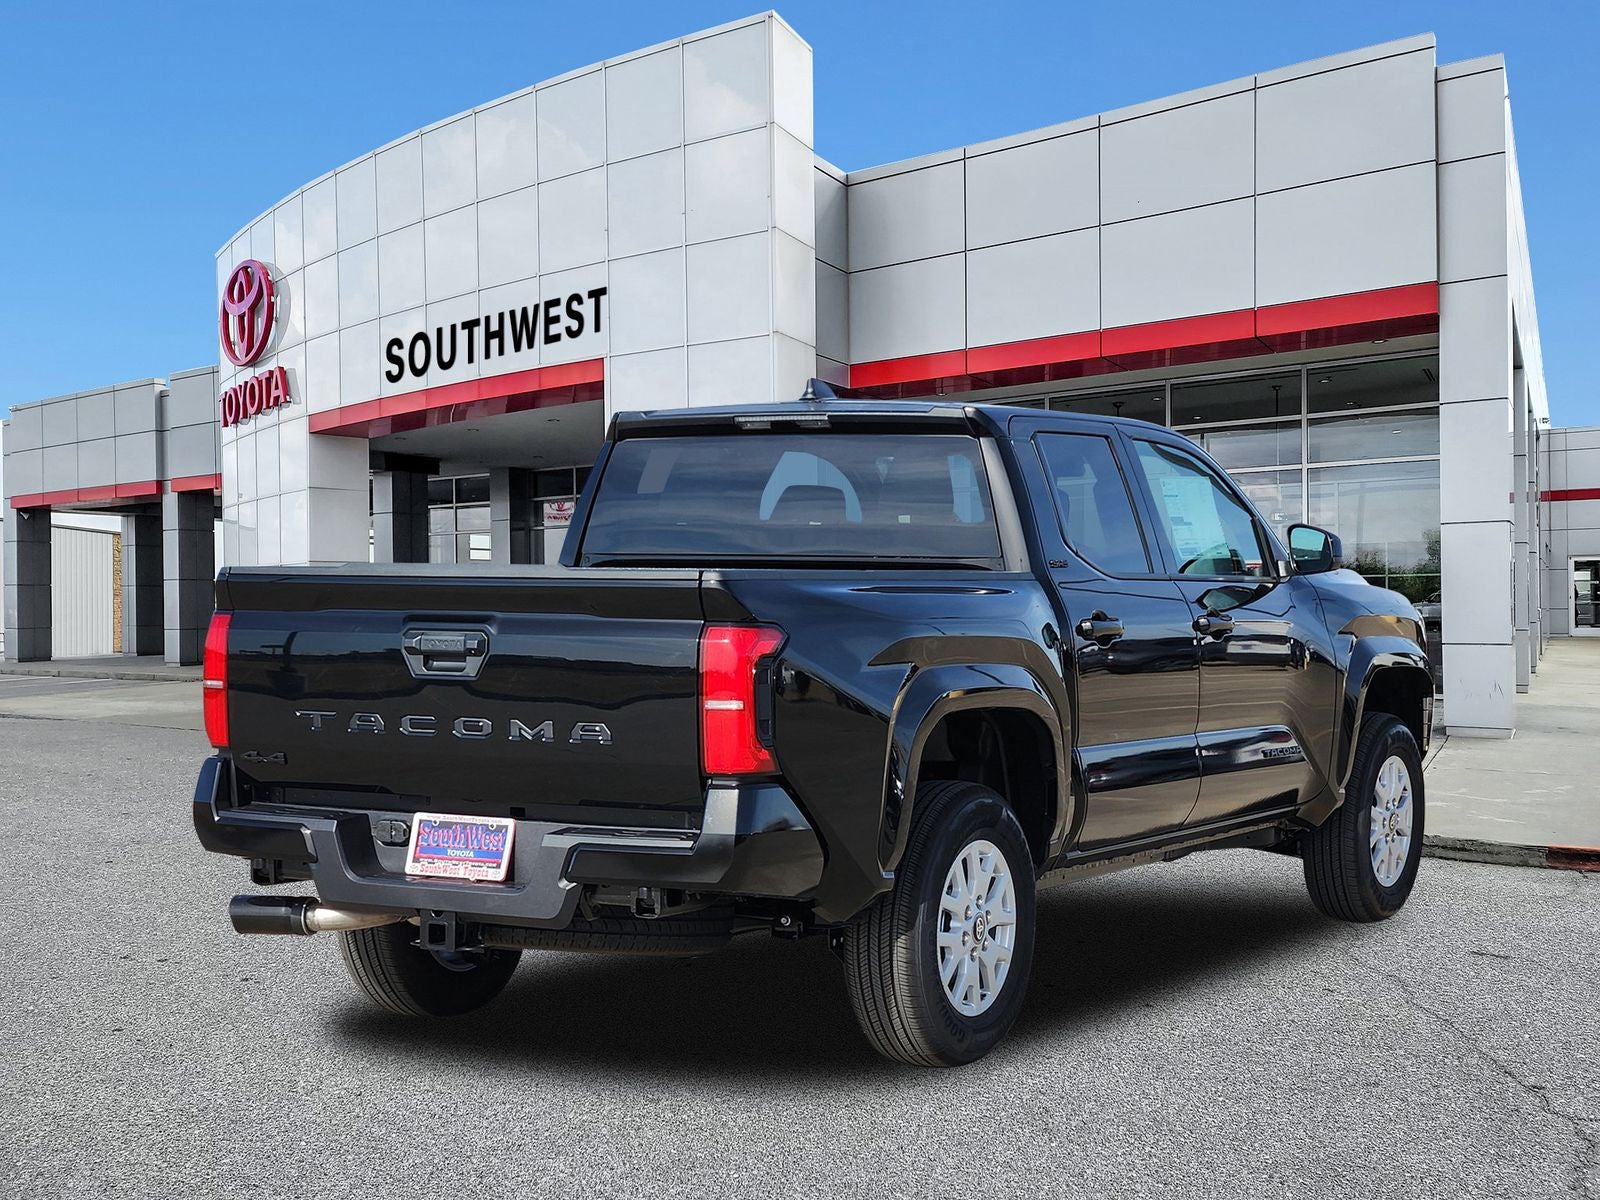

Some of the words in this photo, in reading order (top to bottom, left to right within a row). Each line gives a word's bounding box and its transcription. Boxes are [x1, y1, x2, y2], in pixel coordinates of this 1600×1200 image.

[385, 286, 608, 384] SOUTHWEST
[218, 366, 291, 428] TOYOTA
[423, 638, 462, 649] TOYOTA
[295, 709, 614, 745] TACOMA
[447, 849, 475, 857] TOYOTA
